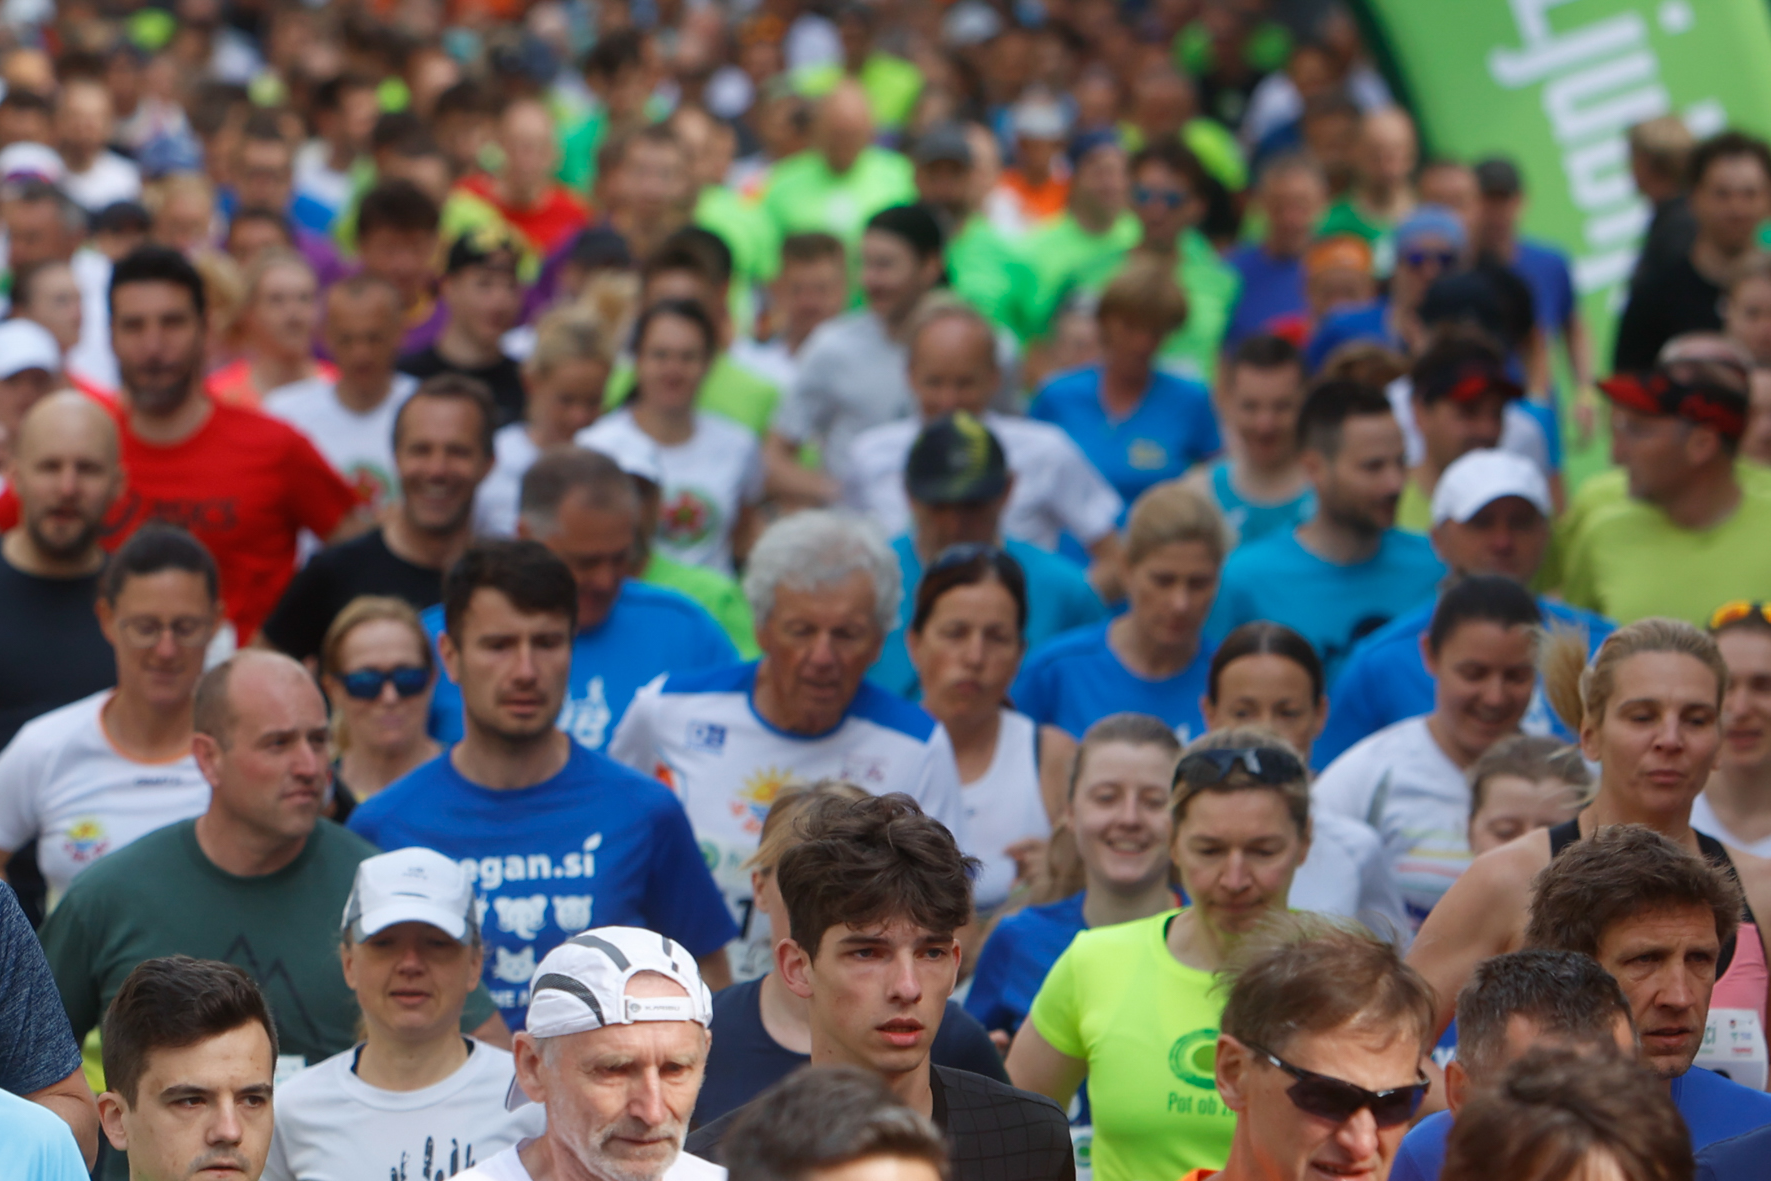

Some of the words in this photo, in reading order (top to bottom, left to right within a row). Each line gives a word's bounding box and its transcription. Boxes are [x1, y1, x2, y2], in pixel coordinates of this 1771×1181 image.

[458, 832, 603, 890] egan.si
[1168, 1091, 1193, 1114] Pot
[1197, 1095, 1218, 1116] ob
